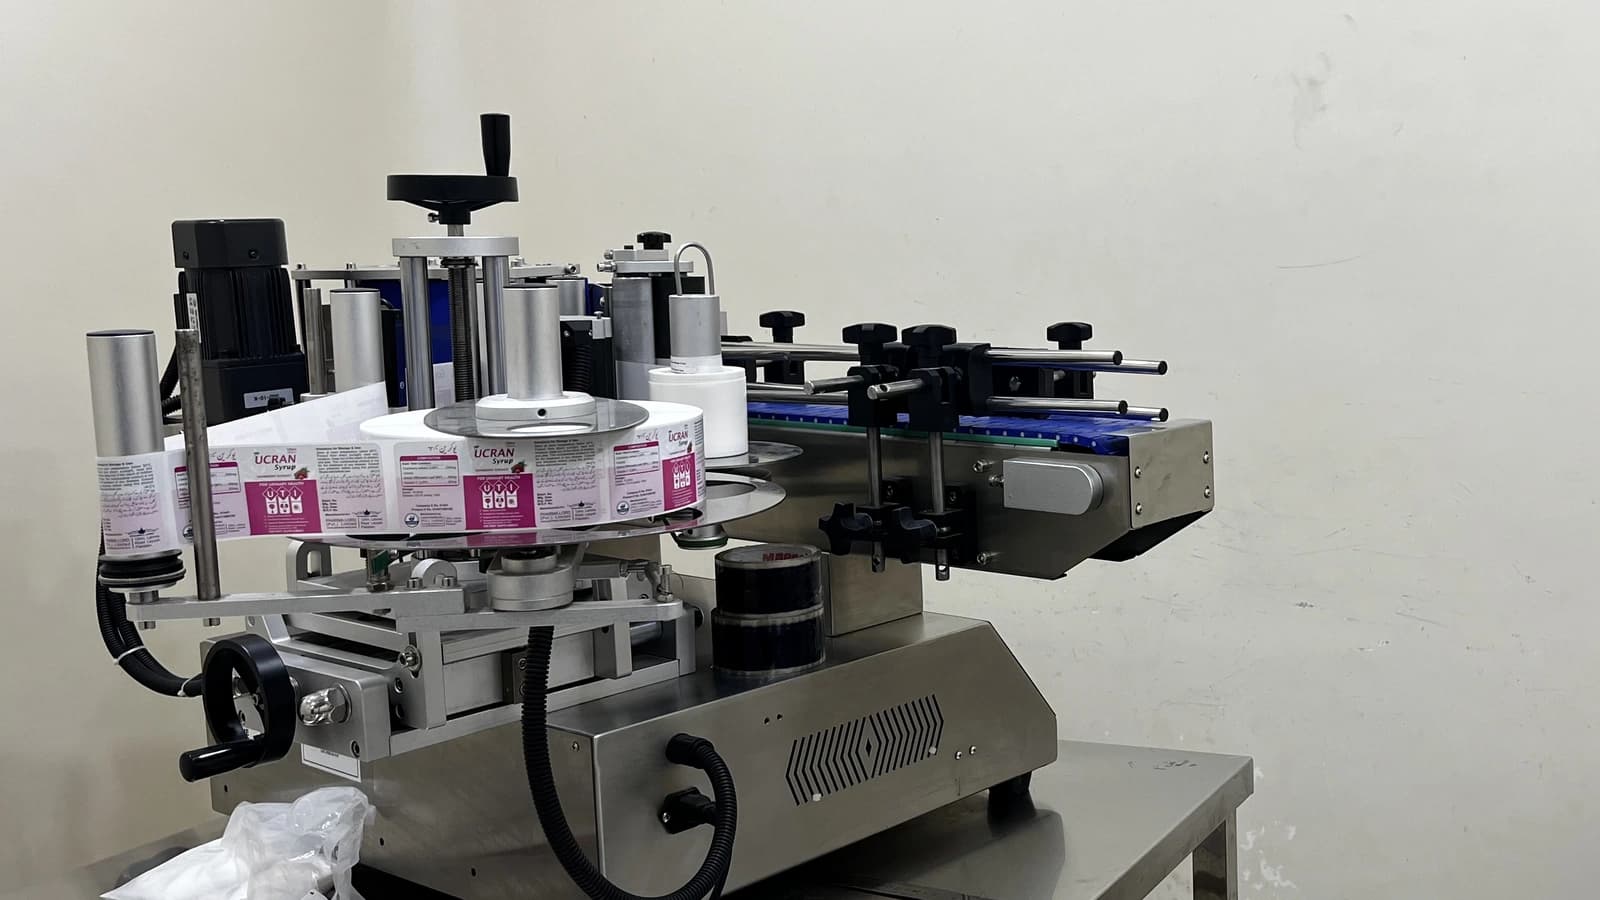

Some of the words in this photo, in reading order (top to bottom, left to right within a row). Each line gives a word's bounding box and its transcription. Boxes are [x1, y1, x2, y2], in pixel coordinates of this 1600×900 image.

[668, 432, 689, 442] UCRAN
[474, 448, 514, 458] UCRAN
[255, 454, 296, 464] UCRAN
[483, 484, 490, 492] U
[267, 490, 274, 498] U
